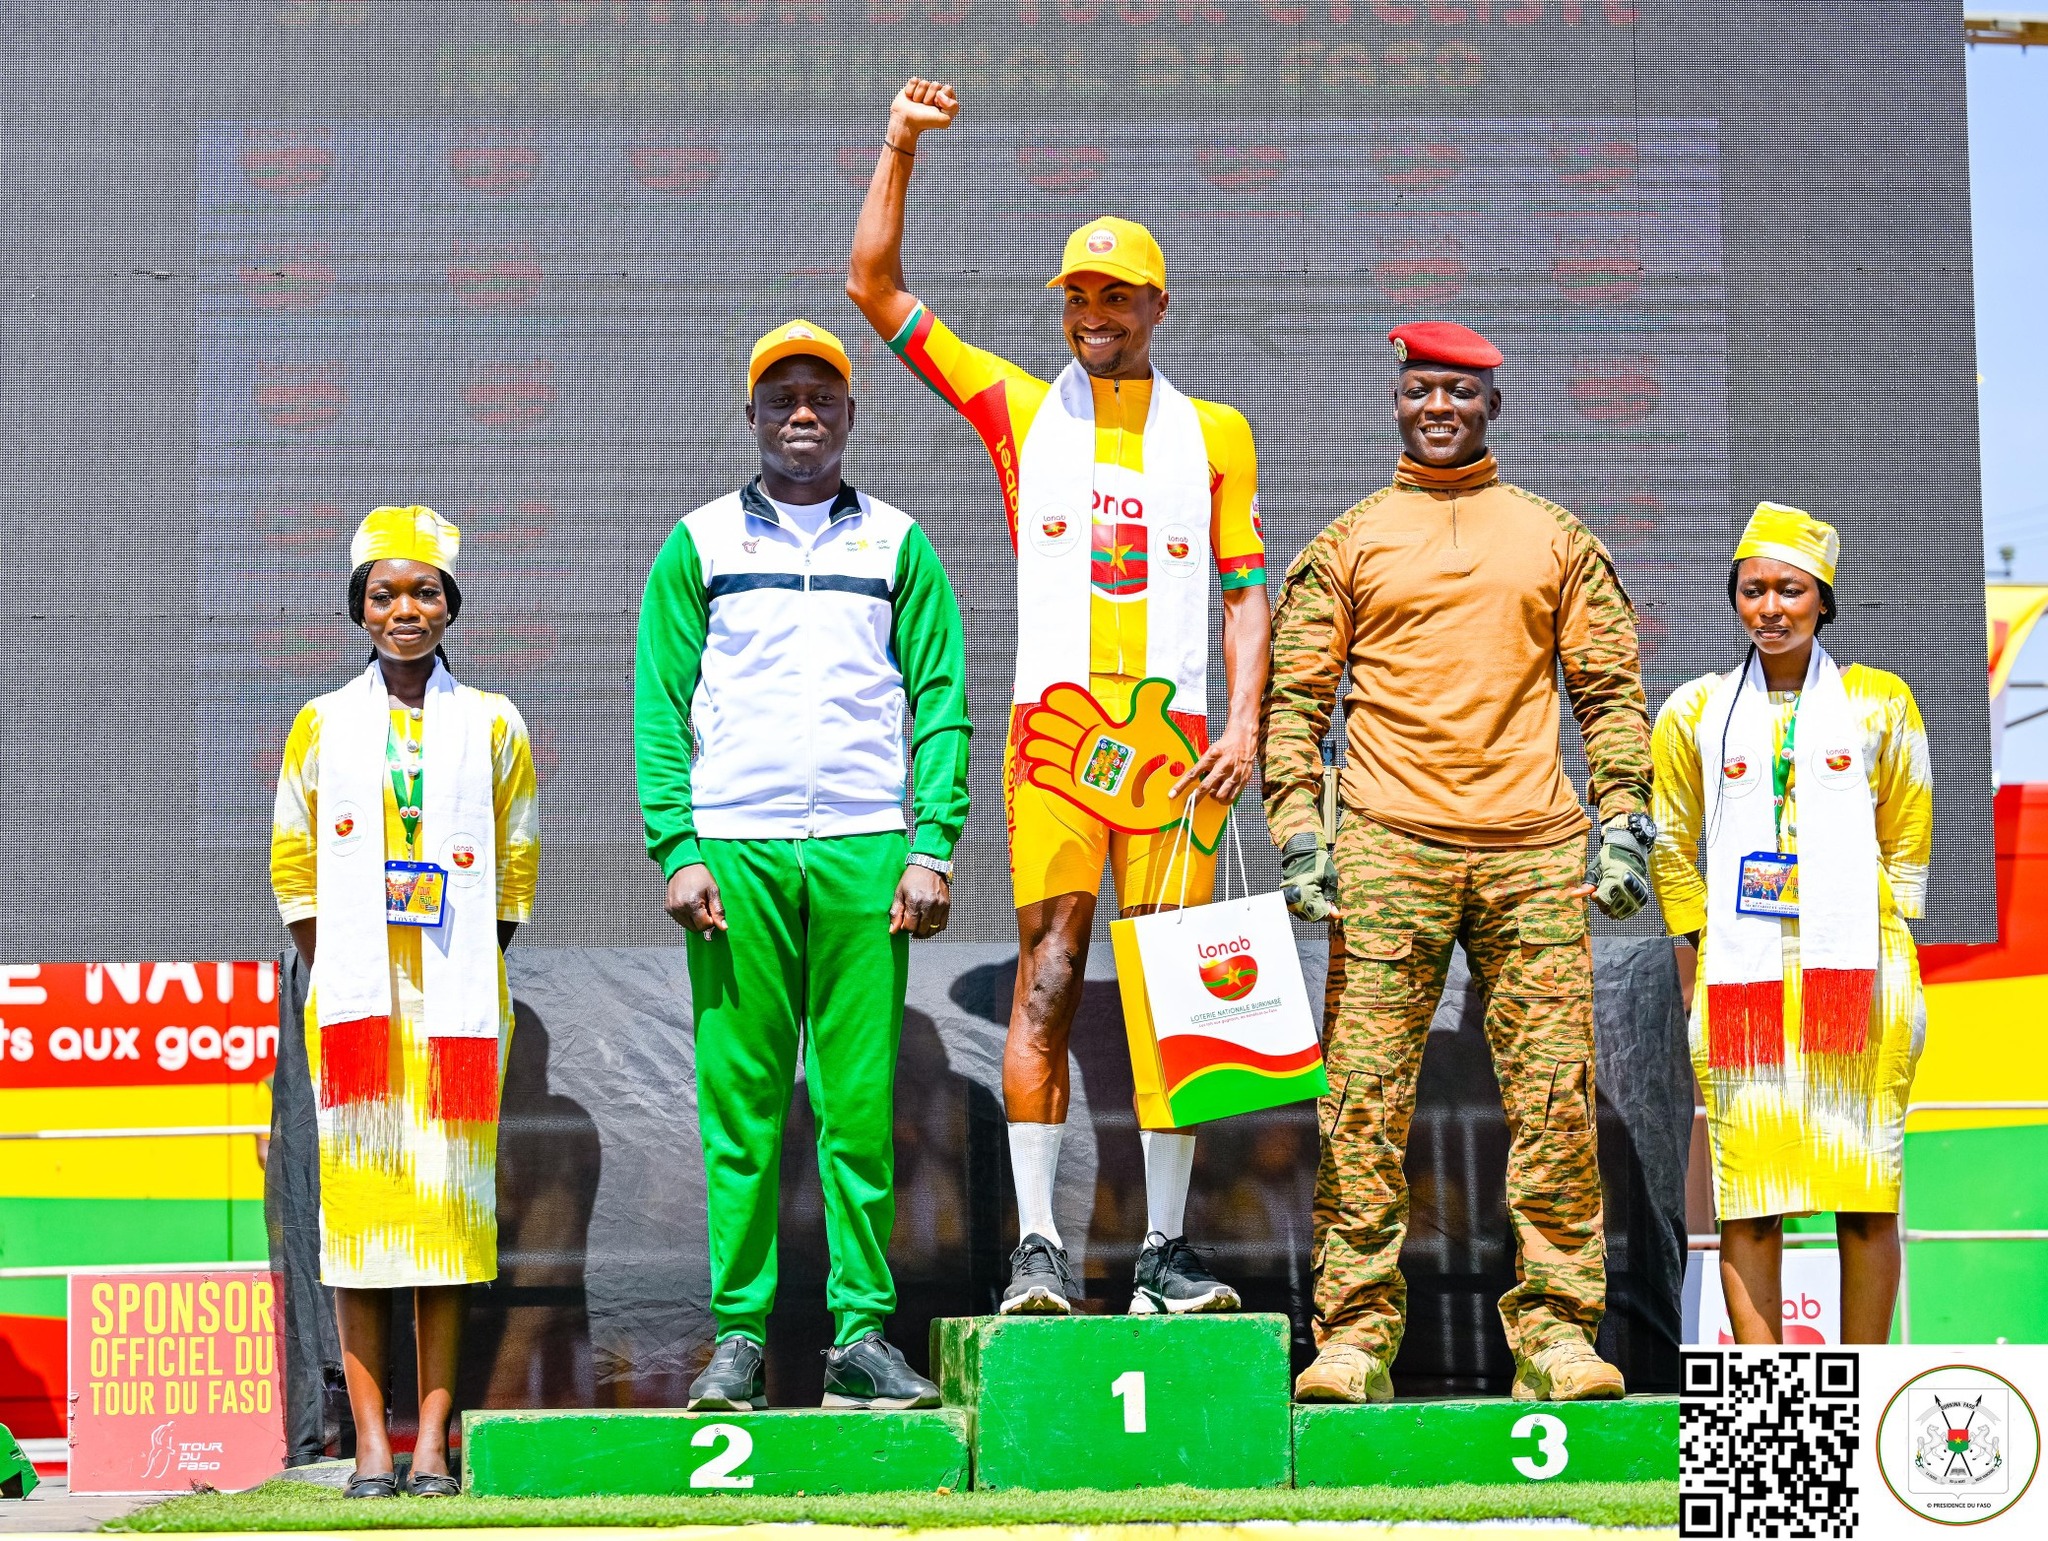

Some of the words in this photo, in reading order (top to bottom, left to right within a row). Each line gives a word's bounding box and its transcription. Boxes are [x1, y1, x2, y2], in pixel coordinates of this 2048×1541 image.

[1197, 935, 1252, 959] lonab
[1190, 1011, 1216, 1022] LOTERIE
[1217, 1004, 1250, 1016] NATIONALE
[48, 1026, 141, 1062] aux
[91, 1281, 275, 1335] SPONSOR
[90, 1336, 223, 1378] OFFICIEL
[235, 1335, 273, 1376] DU
[89, 1381, 155, 1416] TOUR
[165, 1380, 198, 1415] DU
[208, 1379, 272, 1414] FASO
[1111, 1371, 1147, 1433] 1
[178, 1442, 224, 1453] TOUR
[180, 1452, 201, 1461] DU
[690, 1423, 754, 1488] 2
[1510, 1413, 1569, 1480] 3
